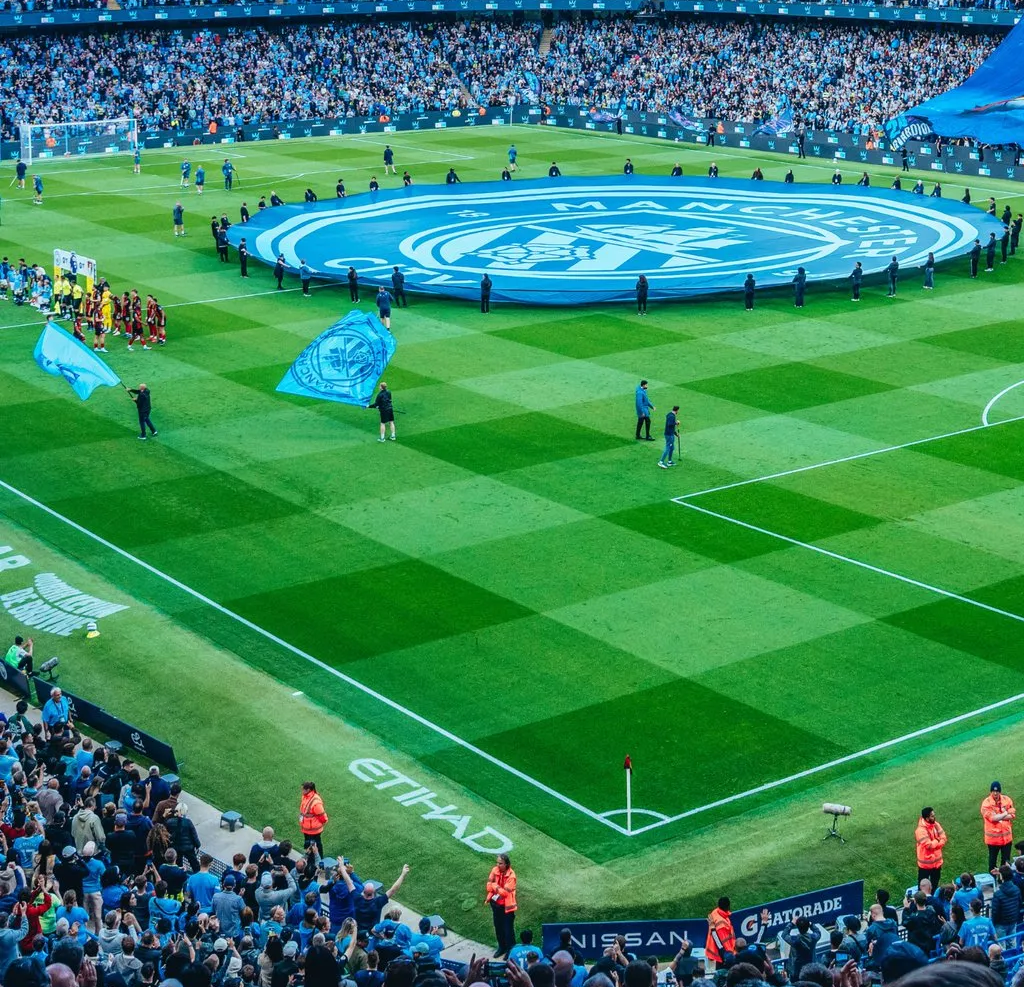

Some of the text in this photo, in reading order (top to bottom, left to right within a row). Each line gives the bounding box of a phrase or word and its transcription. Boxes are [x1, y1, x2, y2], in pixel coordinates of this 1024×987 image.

[551, 200, 918, 259] MANCHESTER
[323, 256, 480, 285] CITY
[348, 757, 514, 854] ETIHAD
[741, 913, 758, 936] G
[569, 930, 688, 949] NISSAN
[972, 932, 988, 945] 17
